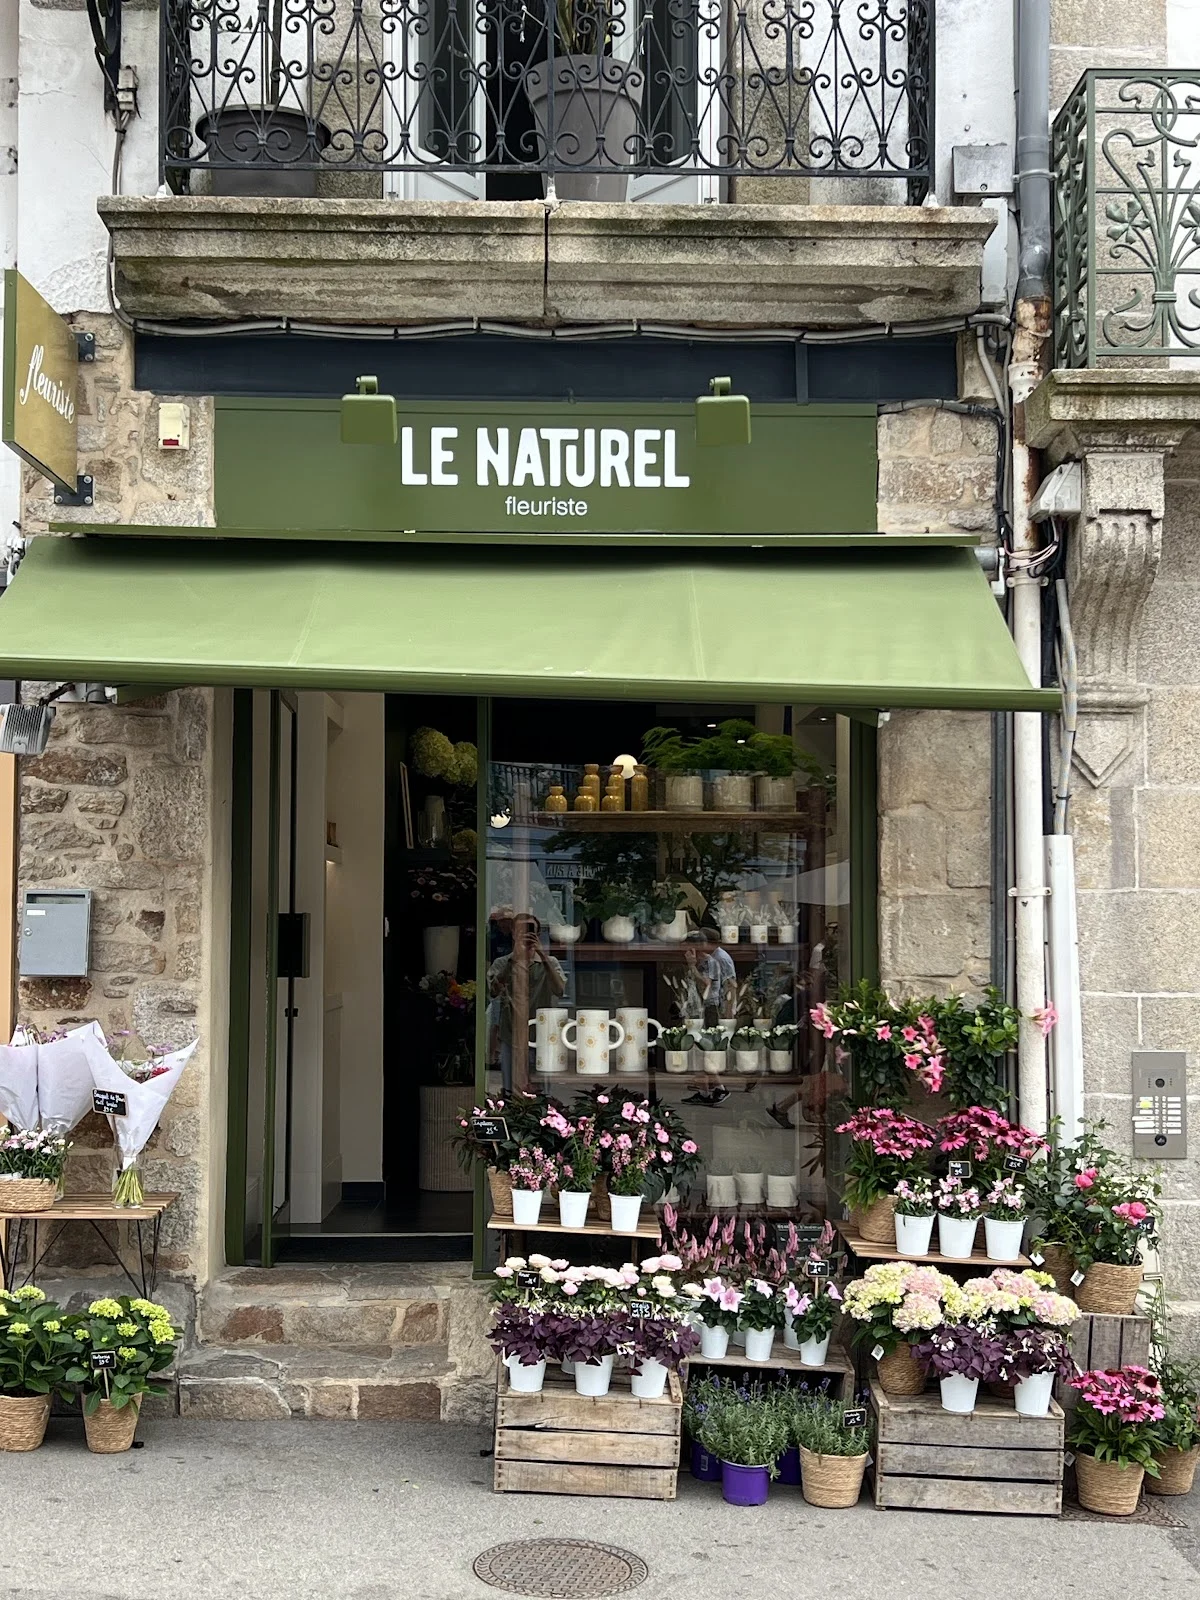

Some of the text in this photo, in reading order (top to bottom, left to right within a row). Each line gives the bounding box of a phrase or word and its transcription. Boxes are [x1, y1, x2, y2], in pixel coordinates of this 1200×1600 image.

[19, 344, 76, 424] fleuriste
[401, 426, 690, 488] LE NATUREL
[504, 495, 588, 516] fleuriste
